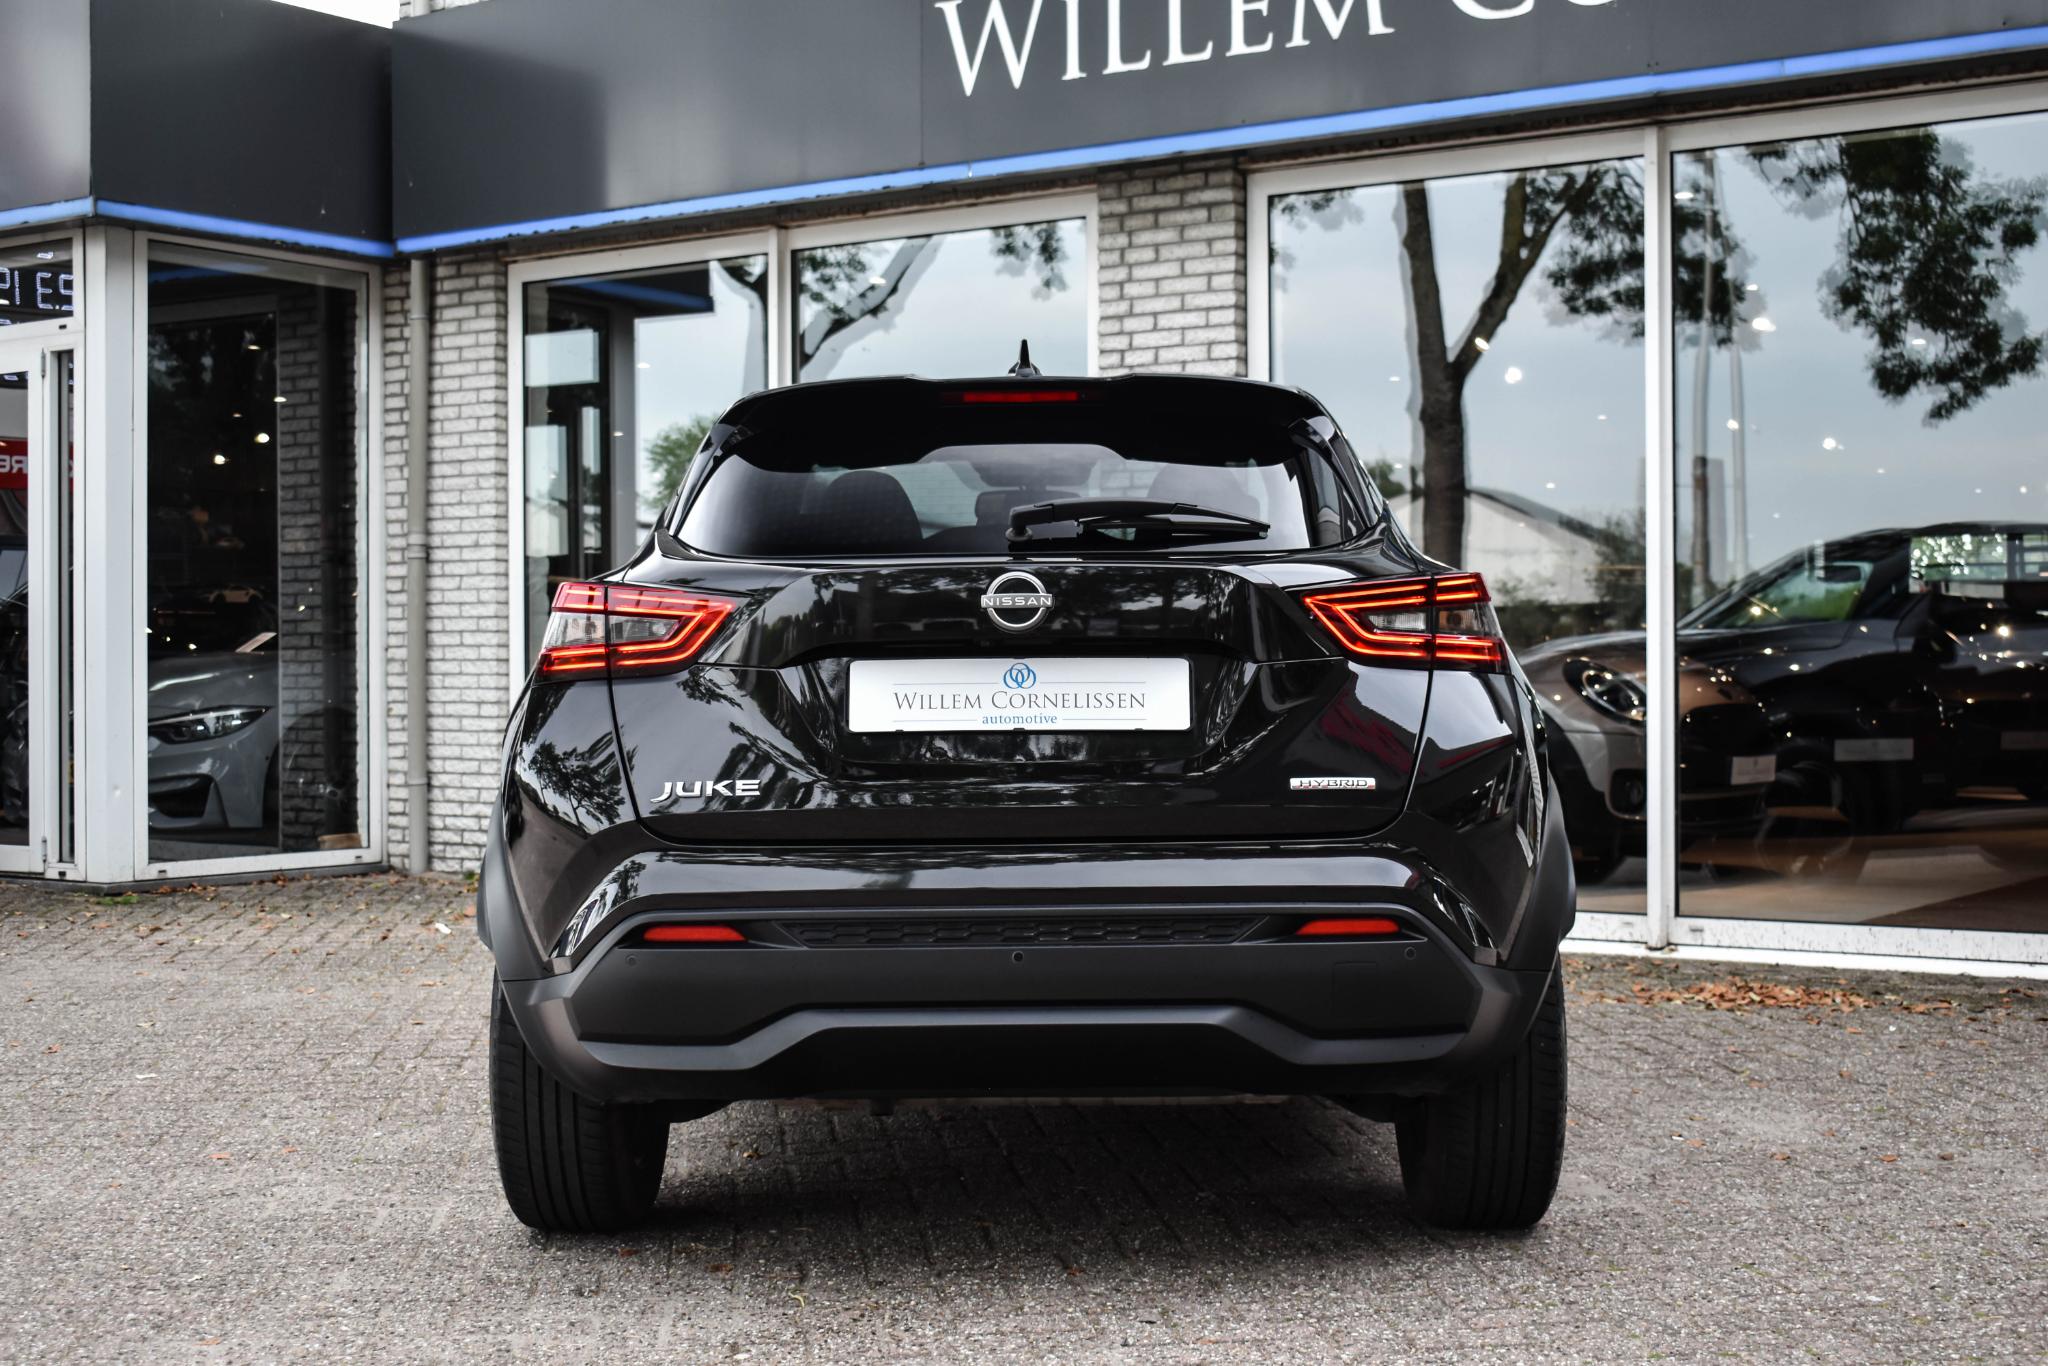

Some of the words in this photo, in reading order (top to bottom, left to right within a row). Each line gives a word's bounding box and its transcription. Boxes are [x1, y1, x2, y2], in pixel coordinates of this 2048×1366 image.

[983, 596, 1052, 606] NISSAN
[893, 691, 982, 710] WILLEM
[991, 690, 1146, 709] CORNELISSEN
[981, 712, 1058, 724] automotive
[1299, 779, 1369, 788] HYBRID
[649, 779, 761, 803] JUKE
